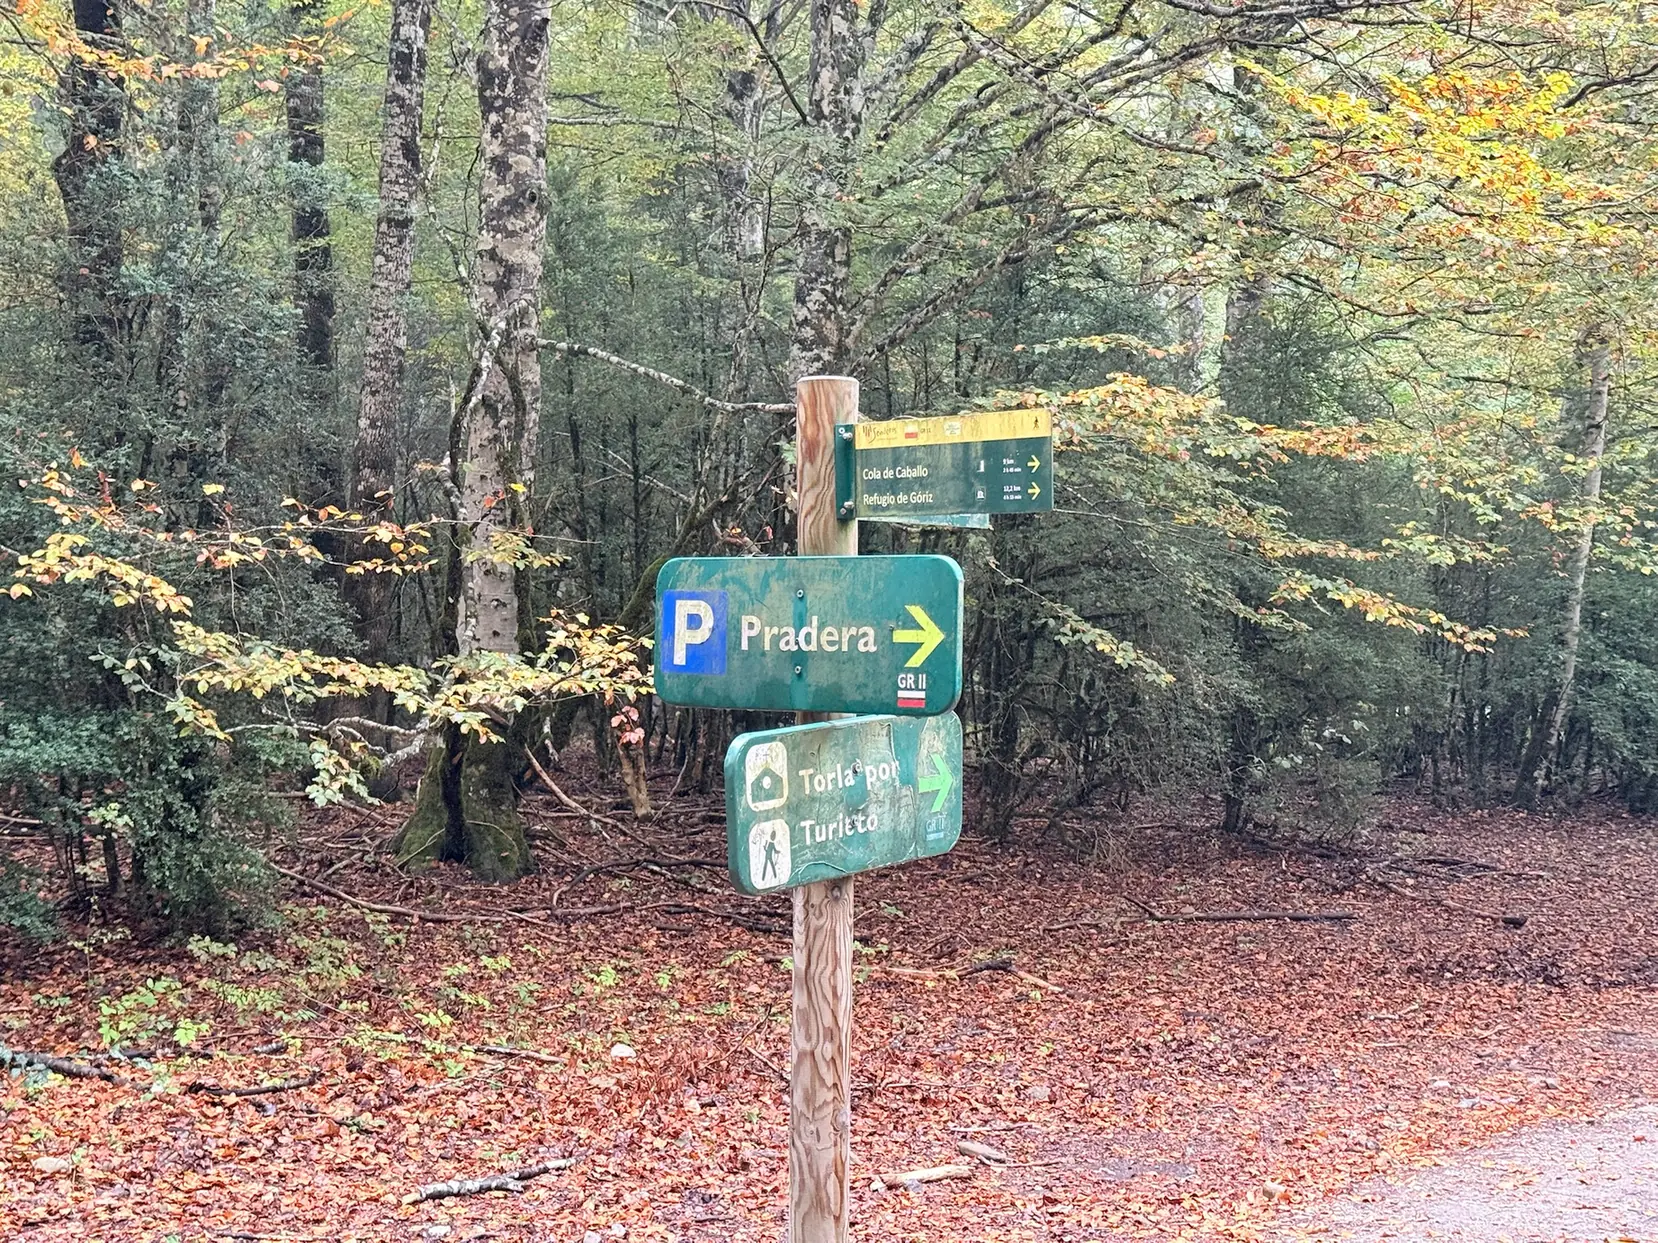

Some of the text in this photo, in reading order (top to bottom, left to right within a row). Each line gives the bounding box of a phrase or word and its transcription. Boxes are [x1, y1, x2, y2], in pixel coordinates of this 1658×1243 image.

[862, 464, 929, 480] Cola de Caballo
[863, 490, 934, 507] Refugio de Góriz
[673, 599, 715, 666] P
[740, 615, 878, 653] Pradera
[897, 673, 915, 689] GR
[798, 760, 900, 795] Torla por
